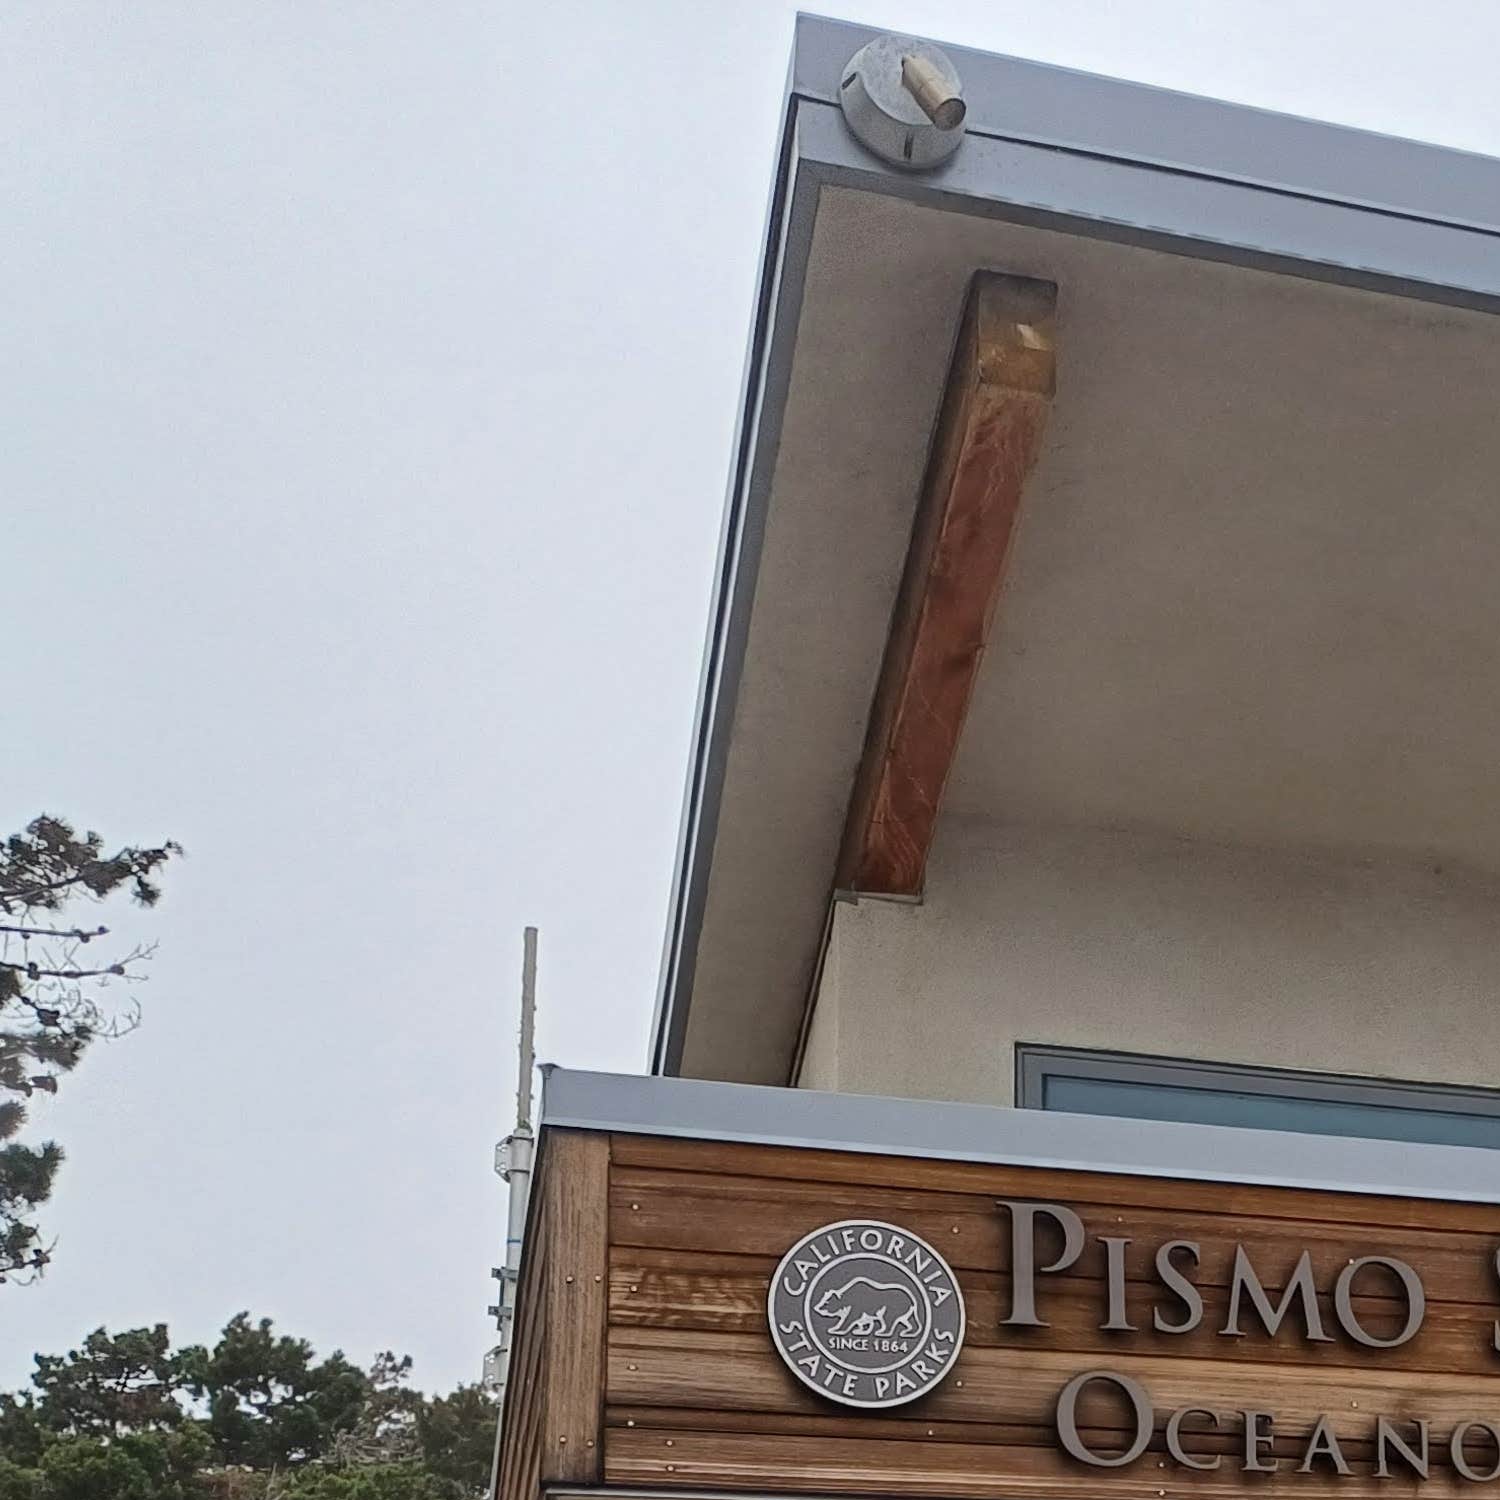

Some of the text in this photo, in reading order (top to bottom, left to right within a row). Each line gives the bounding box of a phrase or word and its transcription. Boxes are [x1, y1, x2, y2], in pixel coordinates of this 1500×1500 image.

[784, 1229, 952, 1307] CALIFORNIA
[997, 1200, 1426, 1349] PISMO
[779, 1321, 955, 1398] STATE PARKS
[828, 1337, 908, 1353] SINCE 1864
